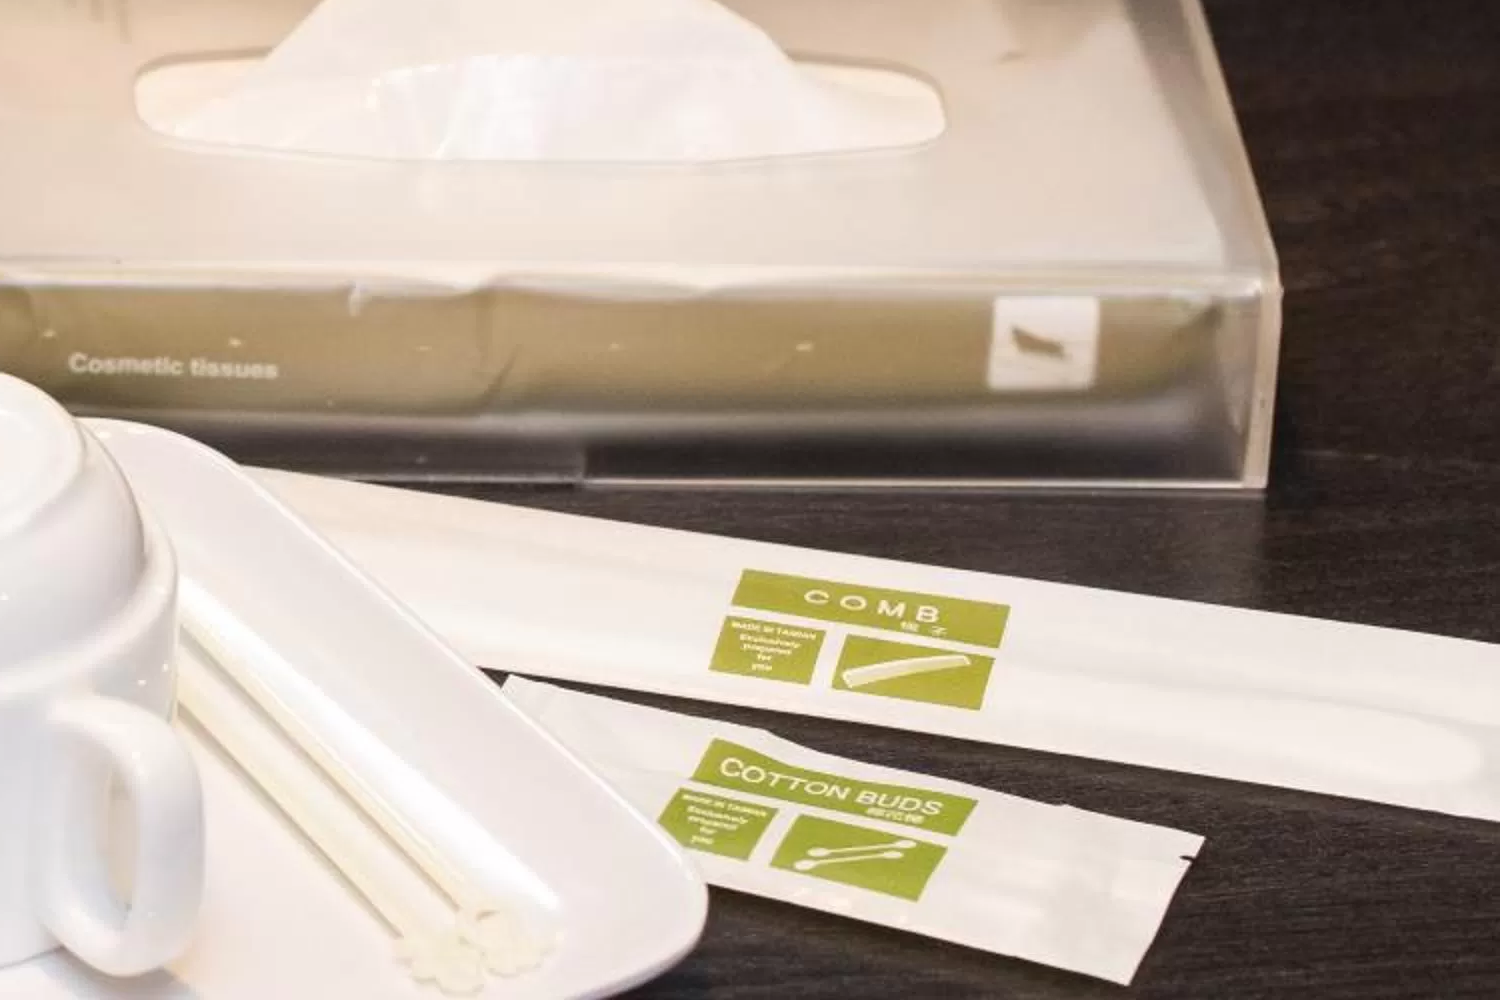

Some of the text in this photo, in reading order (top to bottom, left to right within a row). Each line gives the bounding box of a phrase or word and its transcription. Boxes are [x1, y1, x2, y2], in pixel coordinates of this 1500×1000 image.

[67, 351, 279, 380] Cosmetic tissues
[803, 588, 941, 625] COMB
[719, 757, 853, 802] COTTON
[854, 789, 944, 816] BUDS
